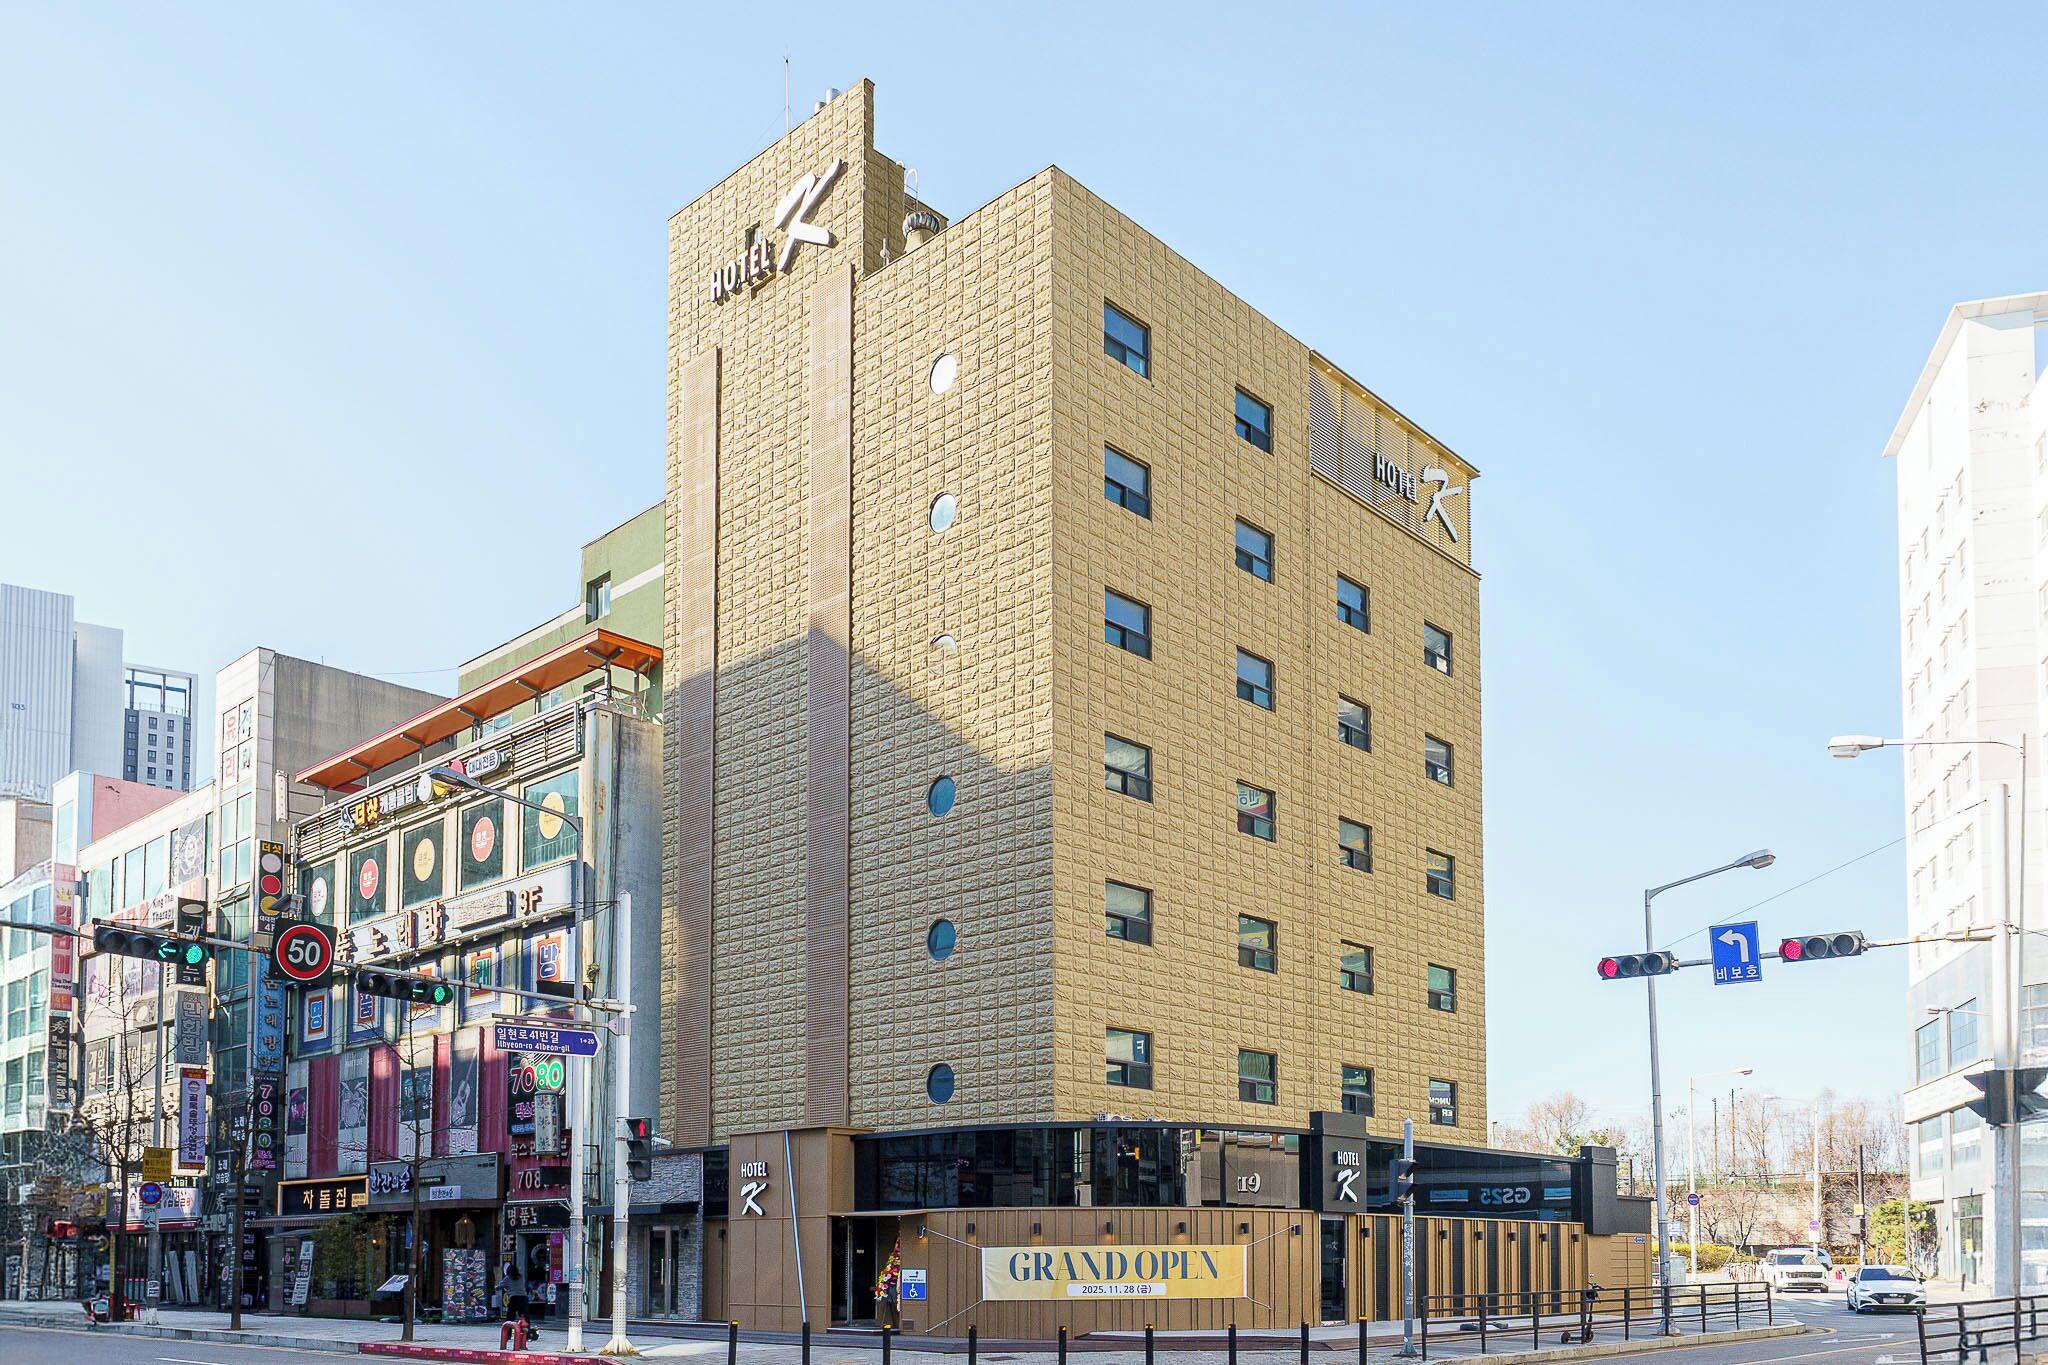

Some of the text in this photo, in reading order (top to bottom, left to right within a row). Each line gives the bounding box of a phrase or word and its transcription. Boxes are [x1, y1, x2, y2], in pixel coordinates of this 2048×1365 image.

[709, 157, 843, 303] HOTEL K
[1374, 451, 1463, 543] HOTEL K
[287, 939, 323, 967] 50
[1715, 963, 1760, 981] 비보호
[497, 1039, 533, 1050] Ilhyeon-ro
[510, 1061, 564, 1095] 7080
[259, 1083, 273, 1149] 7080
[741, 1161, 768, 1178] HOTEL
[1337, 1150, 1360, 1166] HOTEL
[369, 1165, 412, 1194] 한잔의술
[1336, 1168, 1360, 1202] K
[303, 1187, 348, 1210] 차돌집
[740, 1181, 768, 1216] K
[1008, 1250, 1220, 1282] GRAND OPEN
